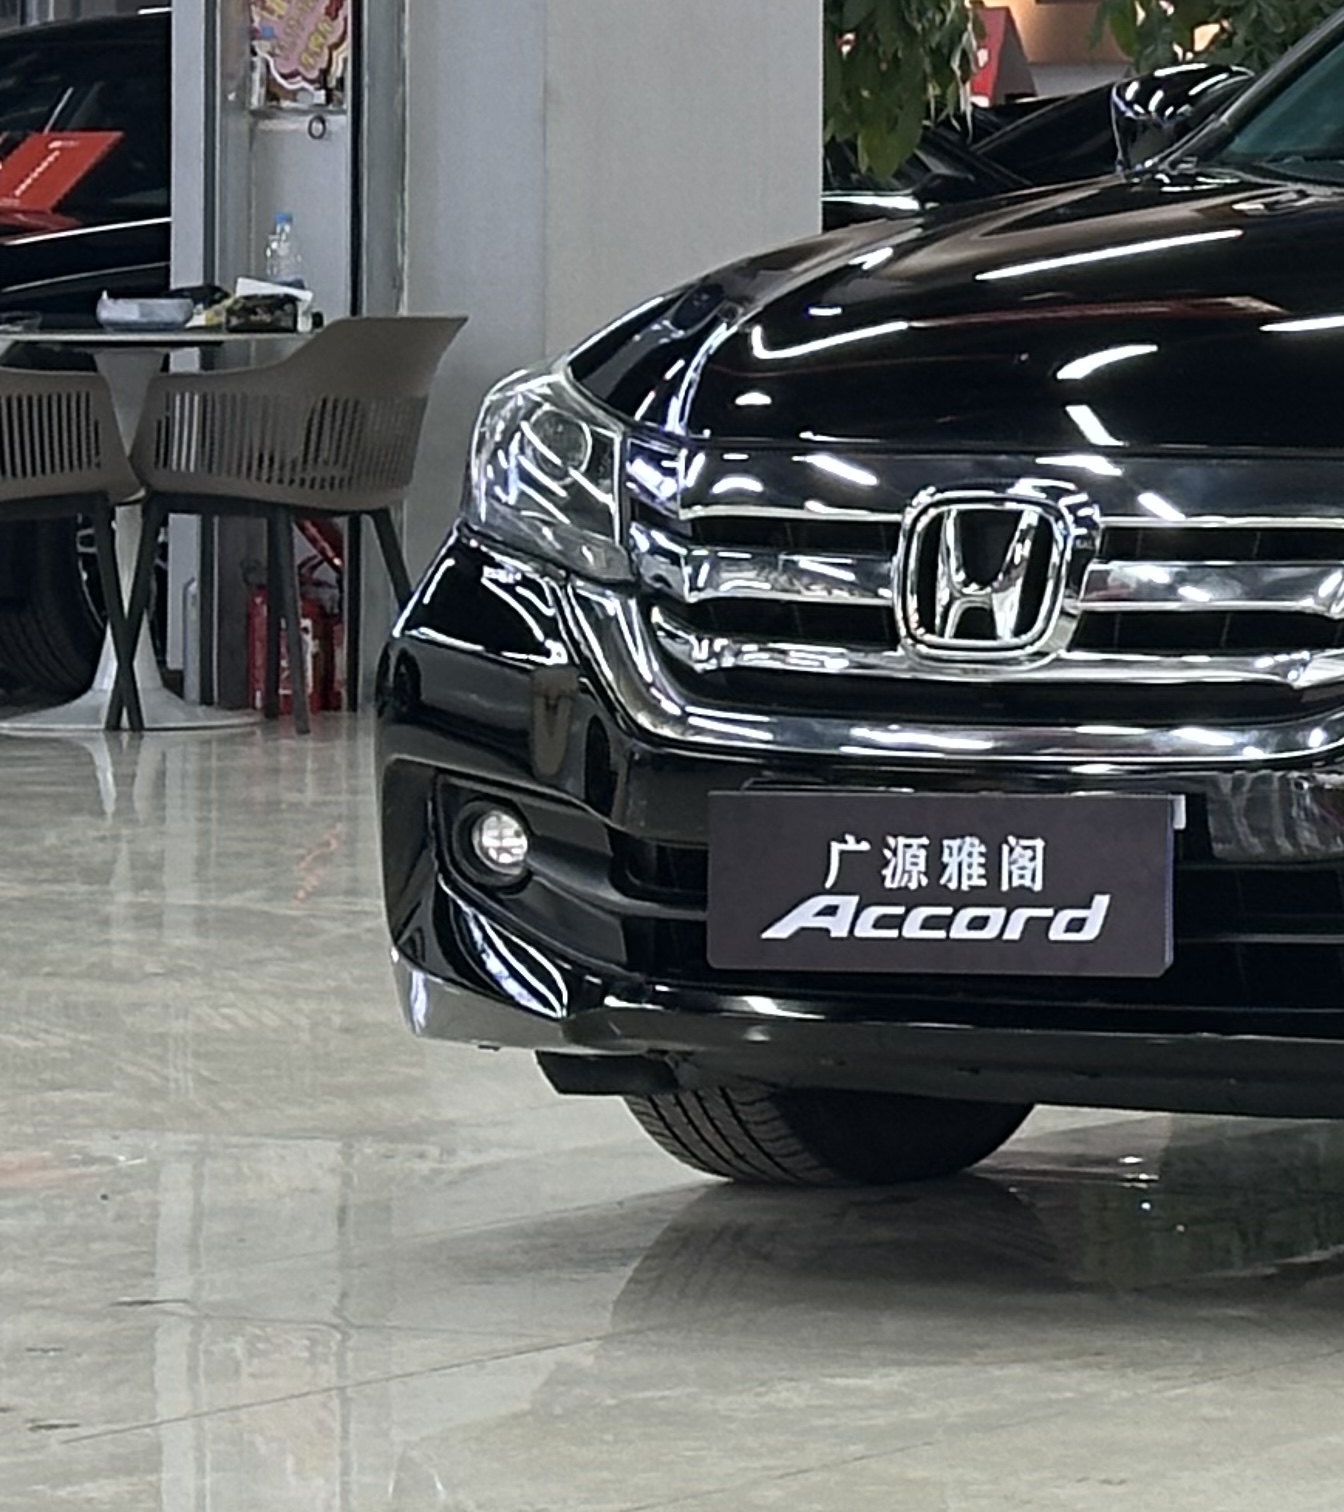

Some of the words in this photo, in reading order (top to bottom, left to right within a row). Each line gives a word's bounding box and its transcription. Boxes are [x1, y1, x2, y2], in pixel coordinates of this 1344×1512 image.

[824, 833, 1048, 893] 广源雅阁
[759, 893, 1113, 942] Accord
